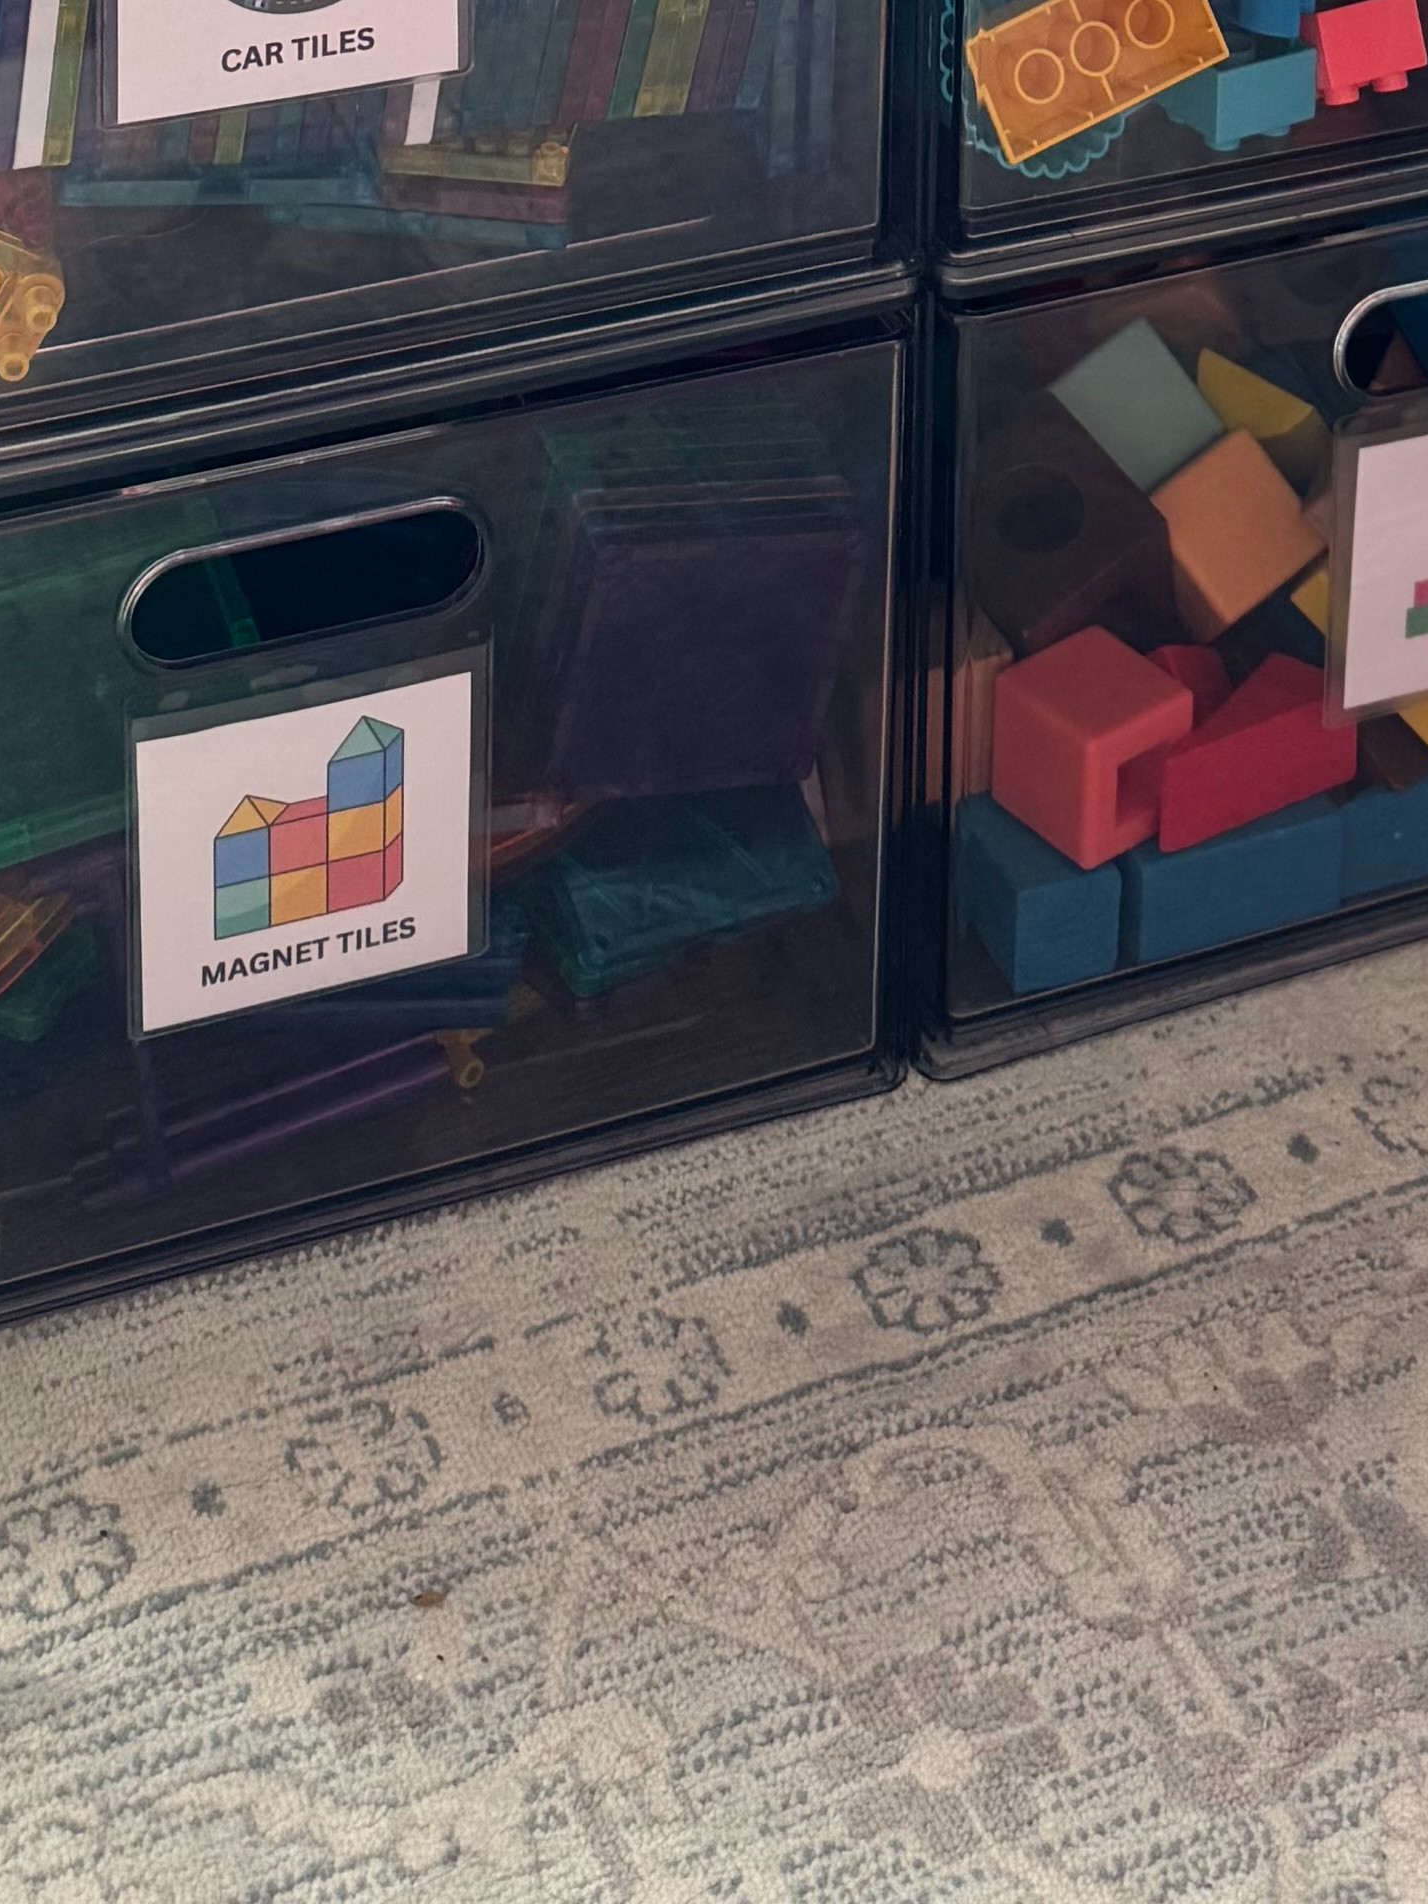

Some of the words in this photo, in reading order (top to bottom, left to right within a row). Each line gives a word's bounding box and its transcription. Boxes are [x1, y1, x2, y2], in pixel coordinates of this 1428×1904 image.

[220, 41, 284, 73] CAR
[291, 27, 375, 62] TILES
[200, 936, 330, 987] MAGNET
[336, 916, 416, 955] TILES
